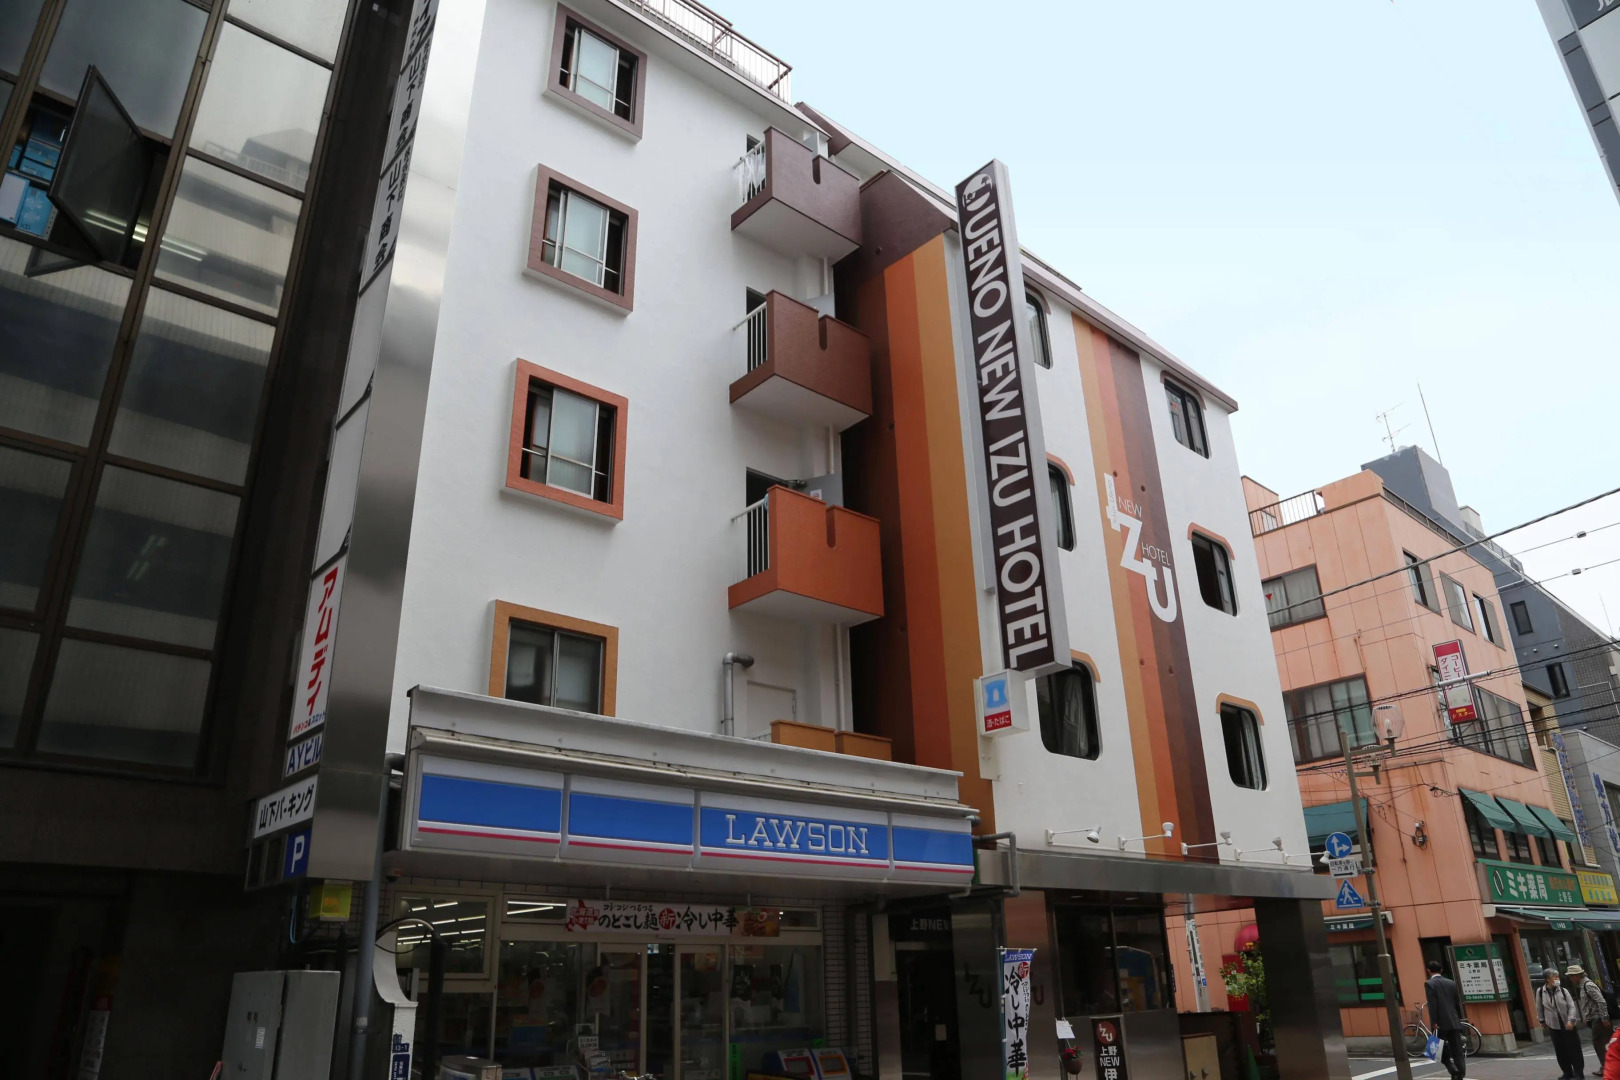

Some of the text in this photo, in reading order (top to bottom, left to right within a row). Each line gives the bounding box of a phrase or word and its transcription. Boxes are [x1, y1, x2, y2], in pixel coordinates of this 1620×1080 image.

[965, 203, 1048, 668] UENO NEW IZU HOTEL
[1118, 496, 1142, 518] NEW
[1141, 542, 1170, 566] HOTEL
[306, 565, 339, 716] アムディ
[287, 735, 323, 775] AYビル
[258, 783, 314, 831] 山下パーキング
[726, 814, 869, 855] LAWSON
[291, 835, 305, 873] P
[1506, 870, 1548, 900] ミキ薬局
[598, 910, 659, 931] のどごし麺
[676, 906, 740, 933] 冷し中華
[1005, 953, 1032, 961] LAWSON
[1005, 966, 1026, 1077] 冷し中華
[1098, 1023, 1113, 1042] IZU
[1099, 1056, 1120, 1067] NEW
[1100, 1046, 1117, 1056] 上野
